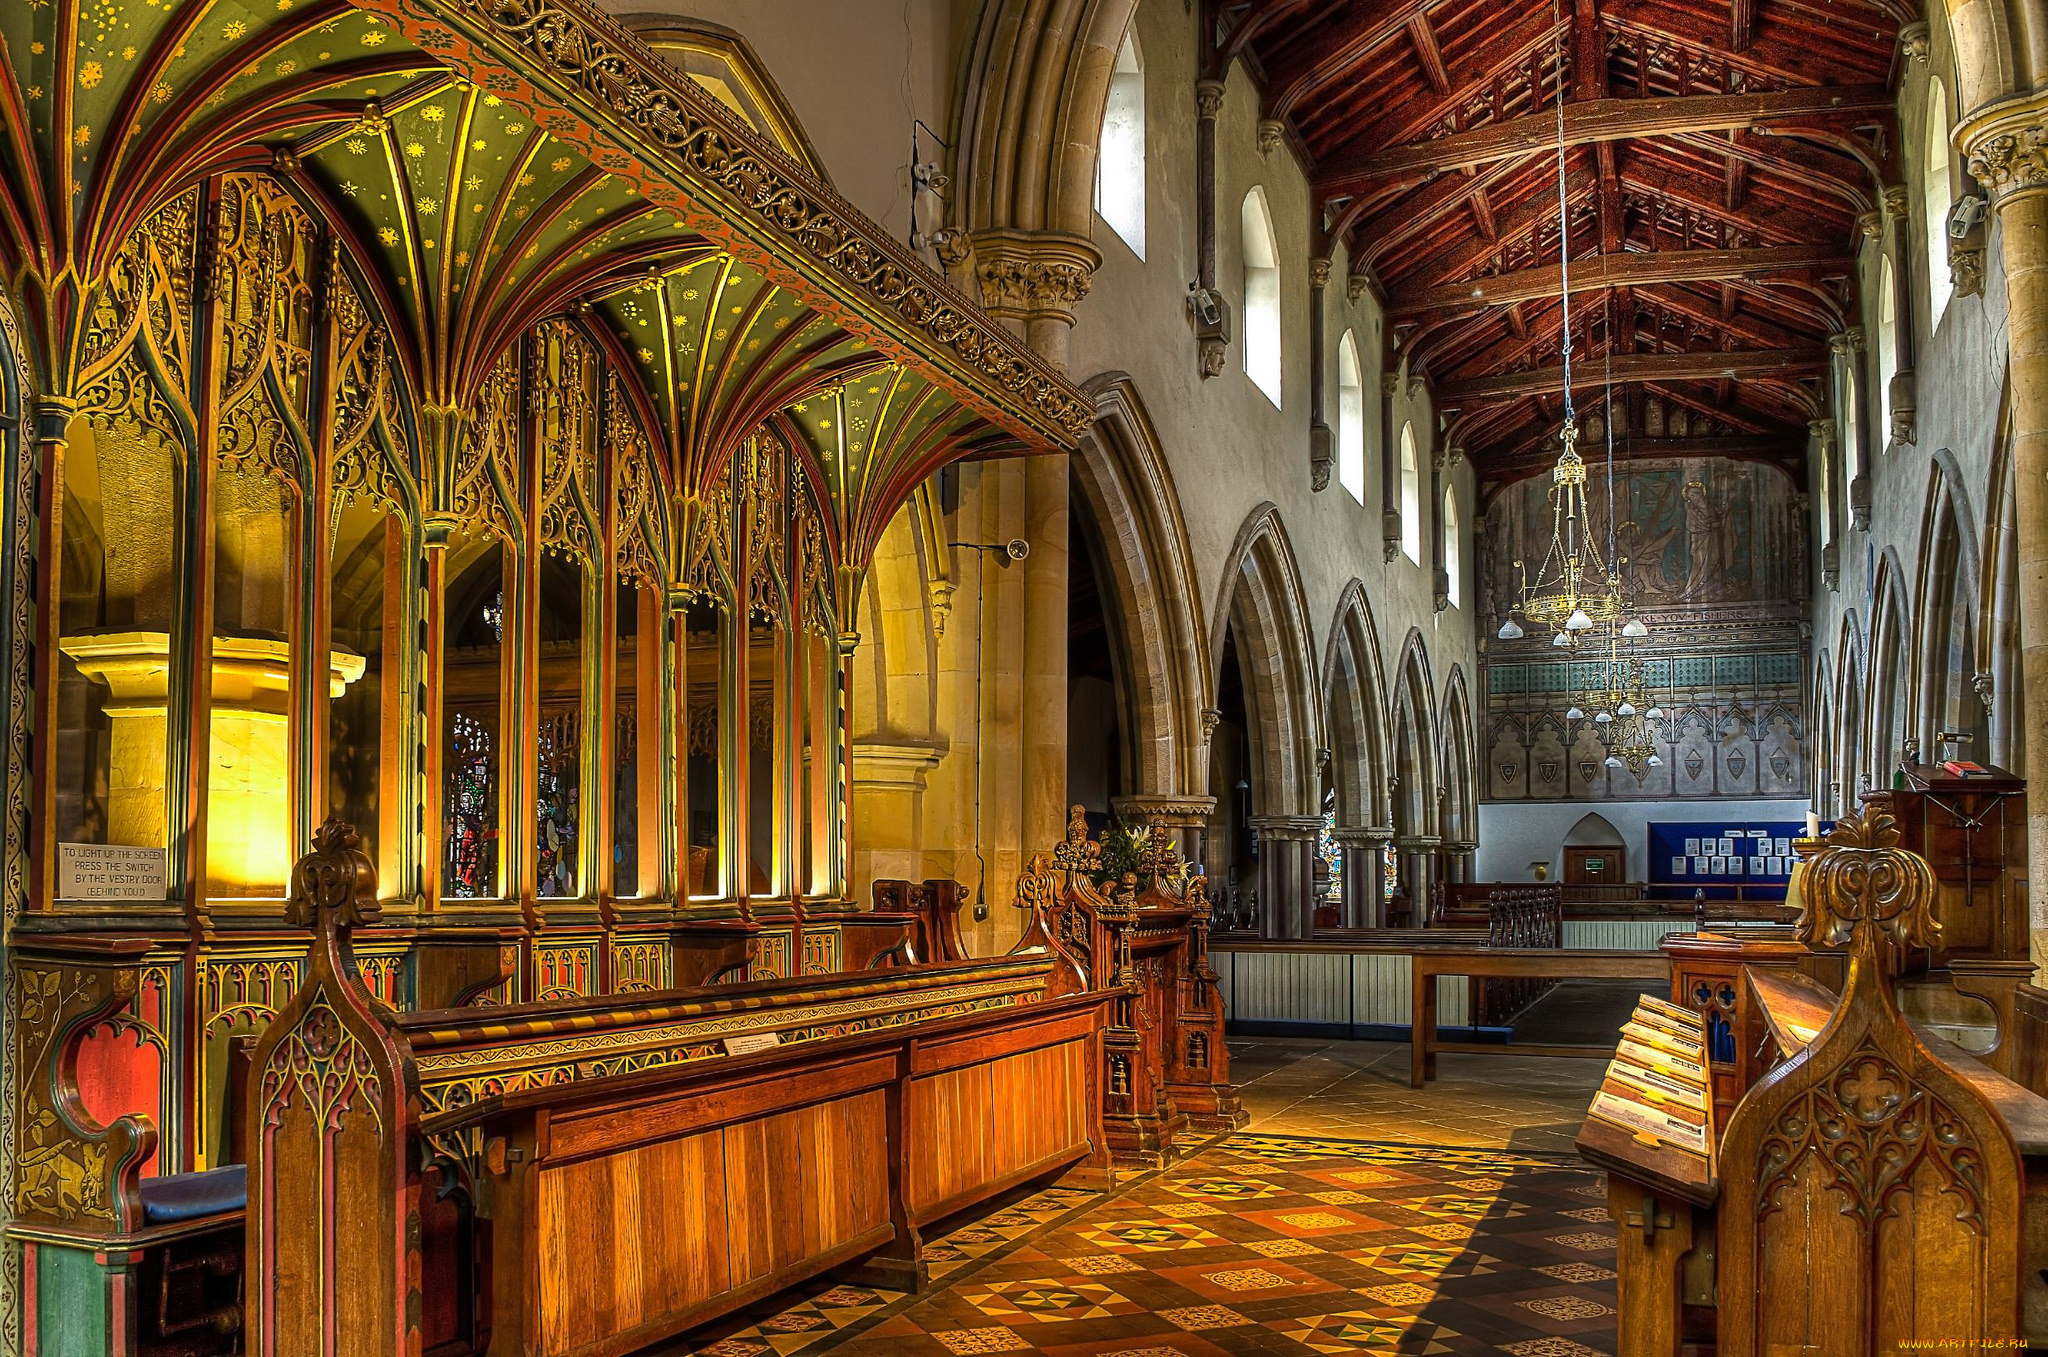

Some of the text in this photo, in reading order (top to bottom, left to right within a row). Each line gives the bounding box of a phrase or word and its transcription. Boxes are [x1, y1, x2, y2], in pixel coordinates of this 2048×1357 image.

[1693, 610, 1744, 621] FISHERS
[64, 848, 164, 861] TO LIGHT UP THE SCREEN
[74, 860, 154, 873] PRESS THE SWITCH
[75, 874, 162, 885] BY THE VESTRY DOOR
[86, 887, 121, 897] (BEHIND
